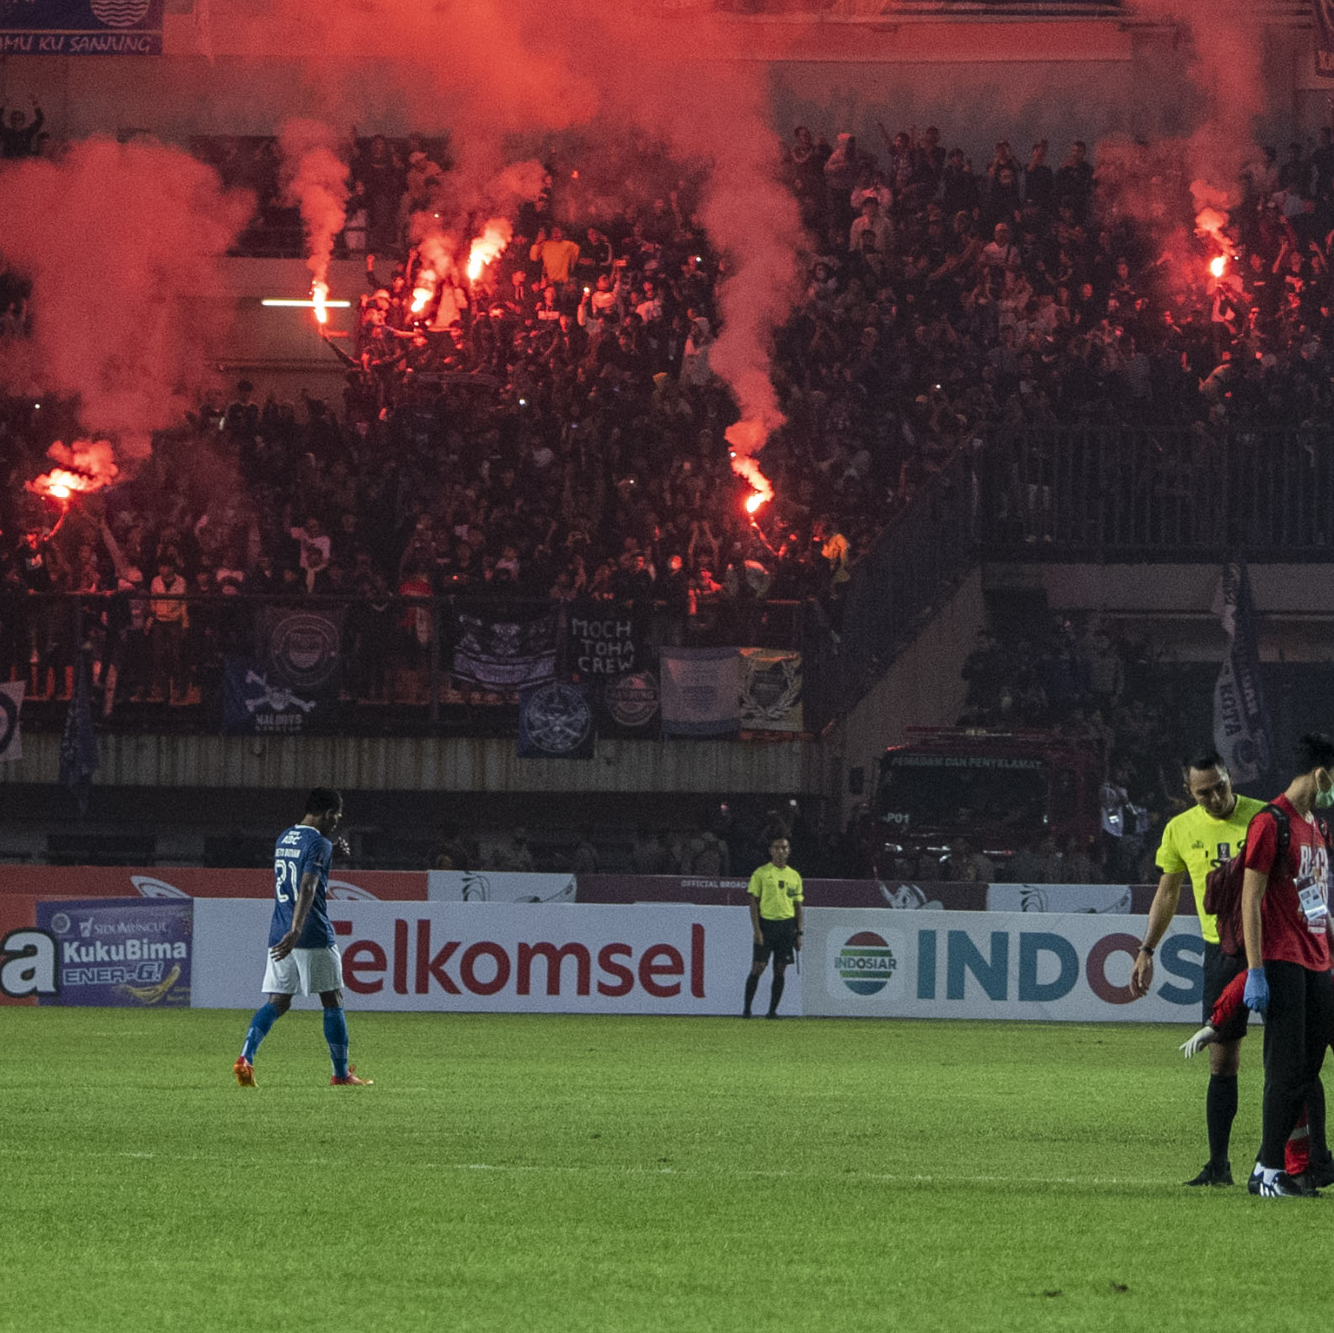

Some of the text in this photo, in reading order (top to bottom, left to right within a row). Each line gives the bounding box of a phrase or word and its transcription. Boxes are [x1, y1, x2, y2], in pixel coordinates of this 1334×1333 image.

[38, 35, 64, 53] KU
[571, 619, 632, 639] MOCH
[580, 638, 635, 655] TOHA
[576, 655, 635, 675] CREW
[62, 938, 188, 964] KukuBima
[834, 957, 897, 971] INDOSIAR
[916, 929, 1206, 1007] INDOS
